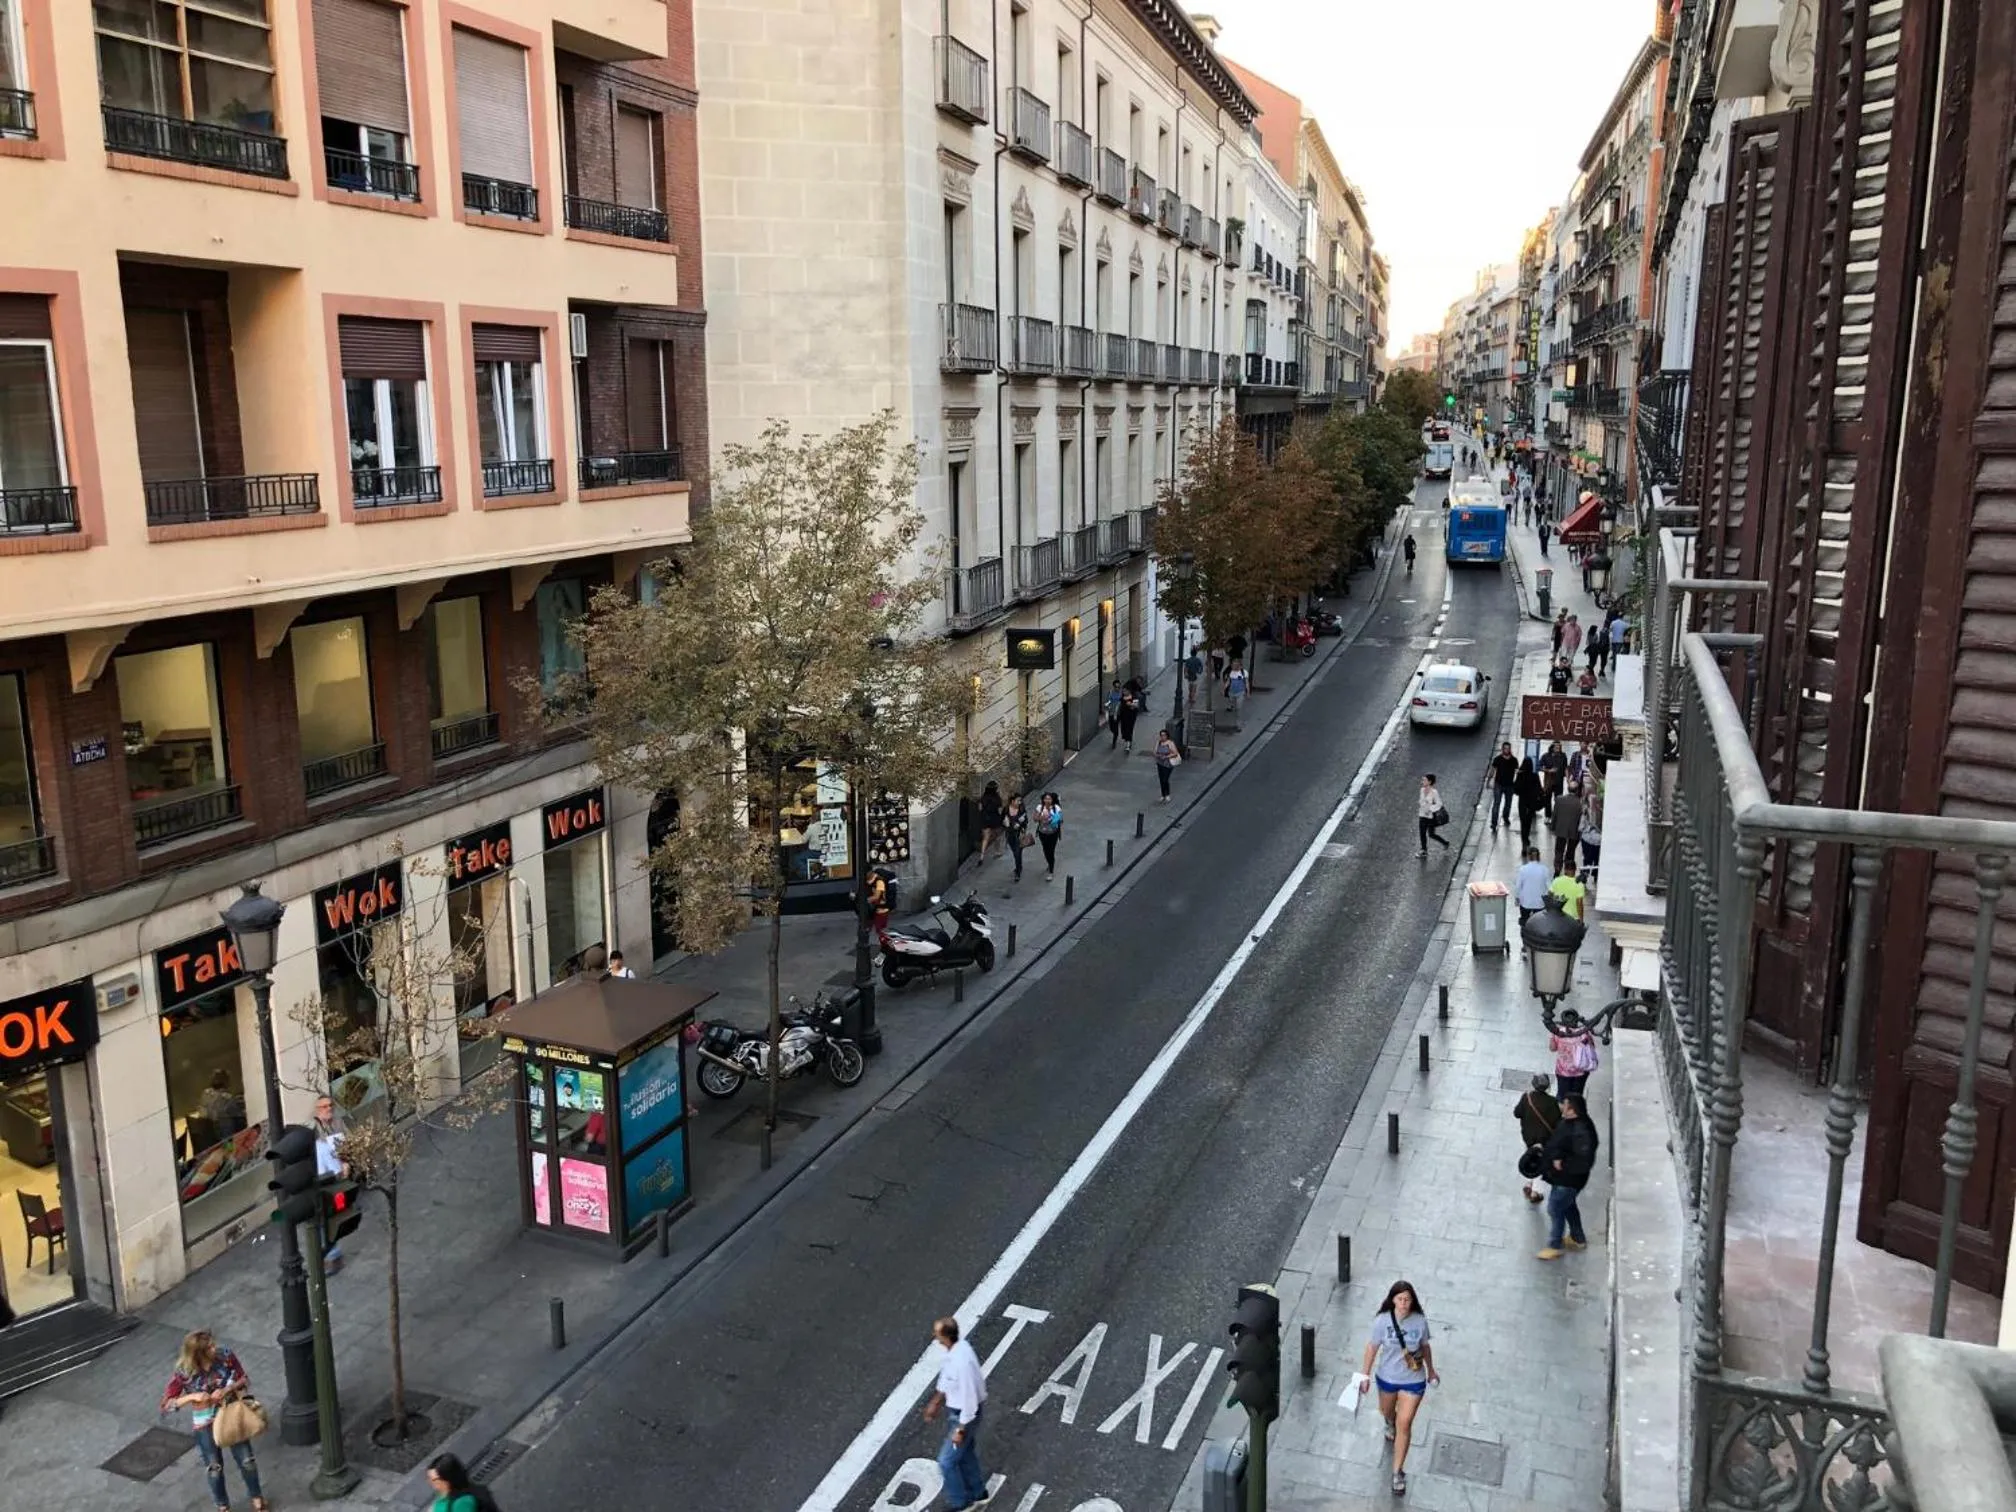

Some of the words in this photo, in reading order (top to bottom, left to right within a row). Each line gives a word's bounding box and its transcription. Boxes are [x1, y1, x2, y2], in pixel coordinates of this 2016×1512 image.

[1532, 719, 1554, 735] LA
[1561, 719, 1609, 737] VERA
[547, 798, 602, 840] Wok
[449, 837, 511, 880] Take
[324, 876, 398, 930] Wok
[163, 938, 241, 993] Tak
[549, 1049, 591, 1065] MILLONES
[982, 1303, 1224, 1451] TAXI
